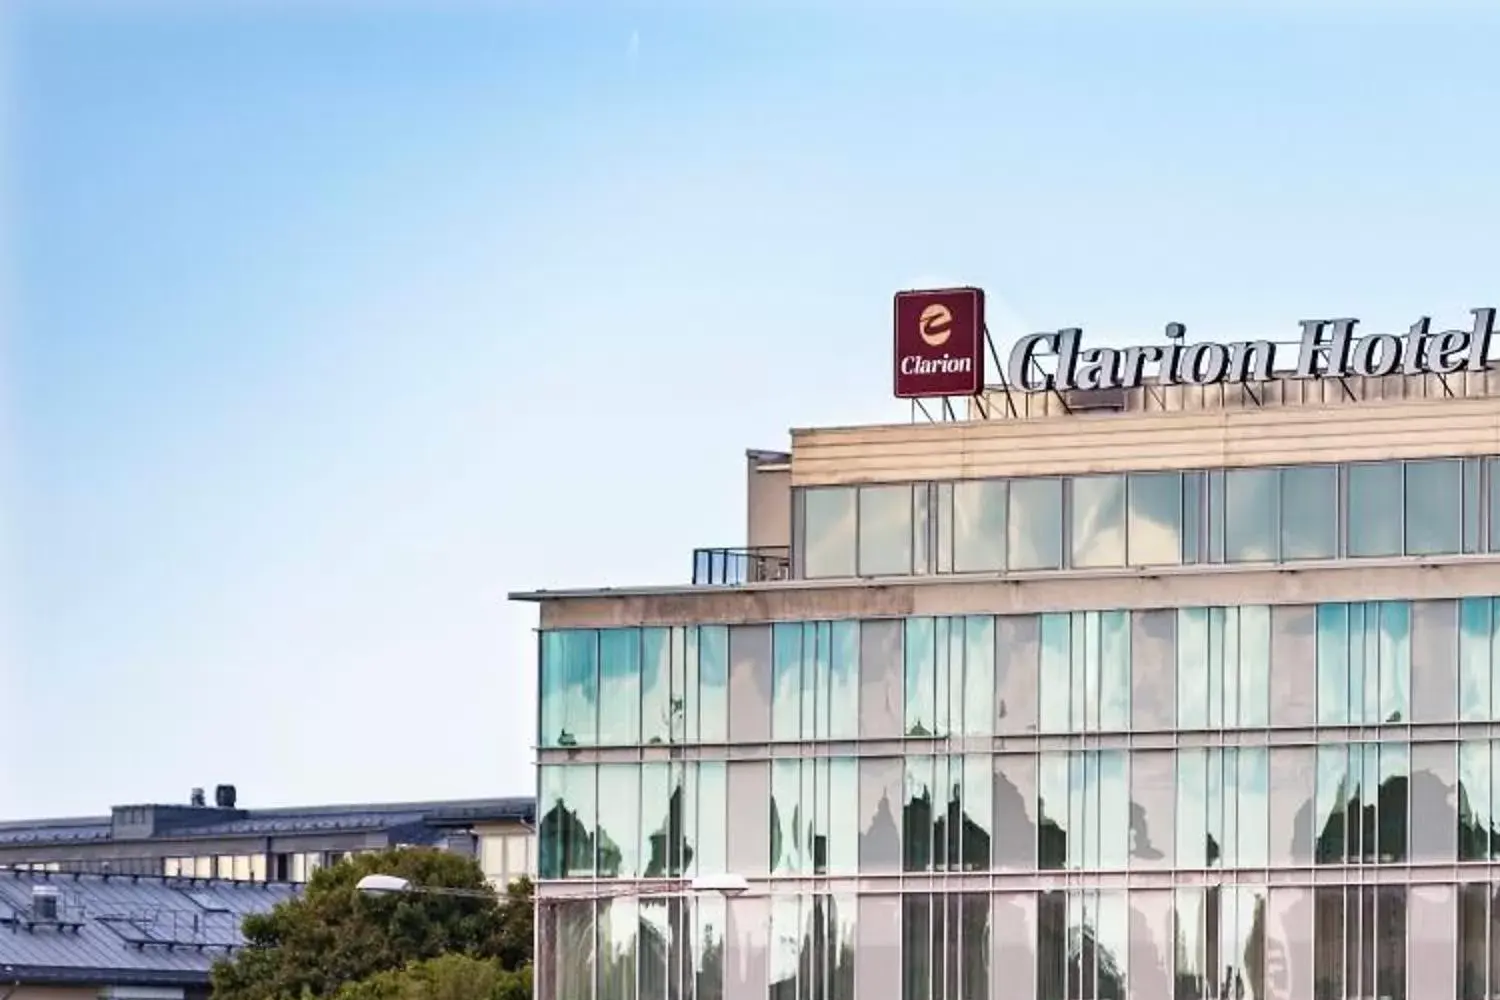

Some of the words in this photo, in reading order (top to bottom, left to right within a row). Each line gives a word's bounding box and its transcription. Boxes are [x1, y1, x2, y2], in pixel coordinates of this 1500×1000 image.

[901, 353, 971, 375] Clarion
[1008, 322, 1277, 393] Clarion
[1298, 308, 1496, 378] Hotel
